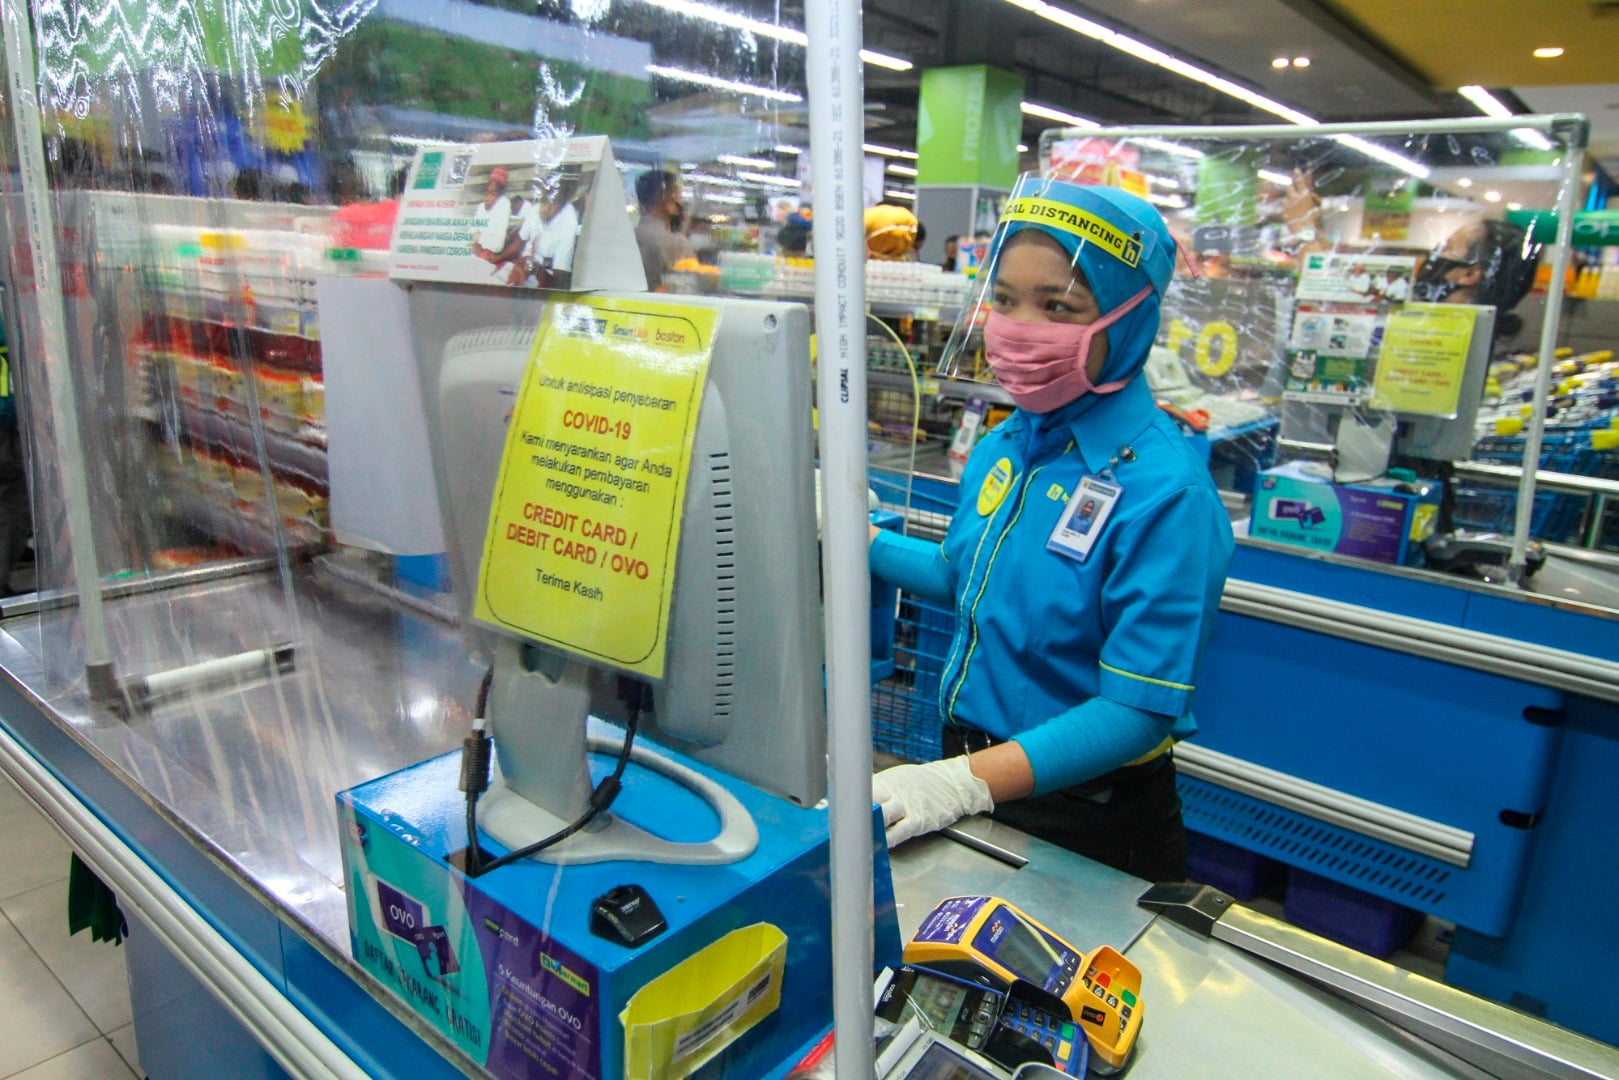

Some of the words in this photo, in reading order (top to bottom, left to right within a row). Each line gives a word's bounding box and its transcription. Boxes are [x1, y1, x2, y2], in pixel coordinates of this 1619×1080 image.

[1029, 204, 1123, 250] DISTANCING
[836, 247, 846, 288] CONDUIT
[837, 294, 847, 328] IMPACT
[655, 328, 686, 345] boston
[838, 333, 848, 359] HIGH
[539, 374, 566, 393] Untuk
[566, 379, 612, 401] antisipasi
[613, 387, 678, 412] penyebaran
[839, 367, 849, 403] CLIPSAL
[562, 408, 633, 441] COVID-19
[521, 430, 545, 449] Kami
[546, 437, 613, 465] menyarankan
[614, 451, 641, 473] agar
[642, 460, 674, 479] Anda
[532, 454, 582, 478] melakukan
[584, 466, 651, 494] pembayaran
[546, 477, 618, 506] menggunakan
[523, 501, 579, 533] CREDIT
[580, 518, 628, 547] CARD
[630, 531, 638, 550] /
[506, 522, 551, 551] DEBIT
[553, 536, 598, 566] CARD
[600, 550, 608, 569] /
[611, 553, 650, 581] OVO
[536, 567, 572, 592] Terima
[573, 583, 604, 603] Kasih
[390, 905, 416, 929] OVO
[505, 971, 557, 1015] Keuntungan
[558, 1007, 582, 1030] OVO
